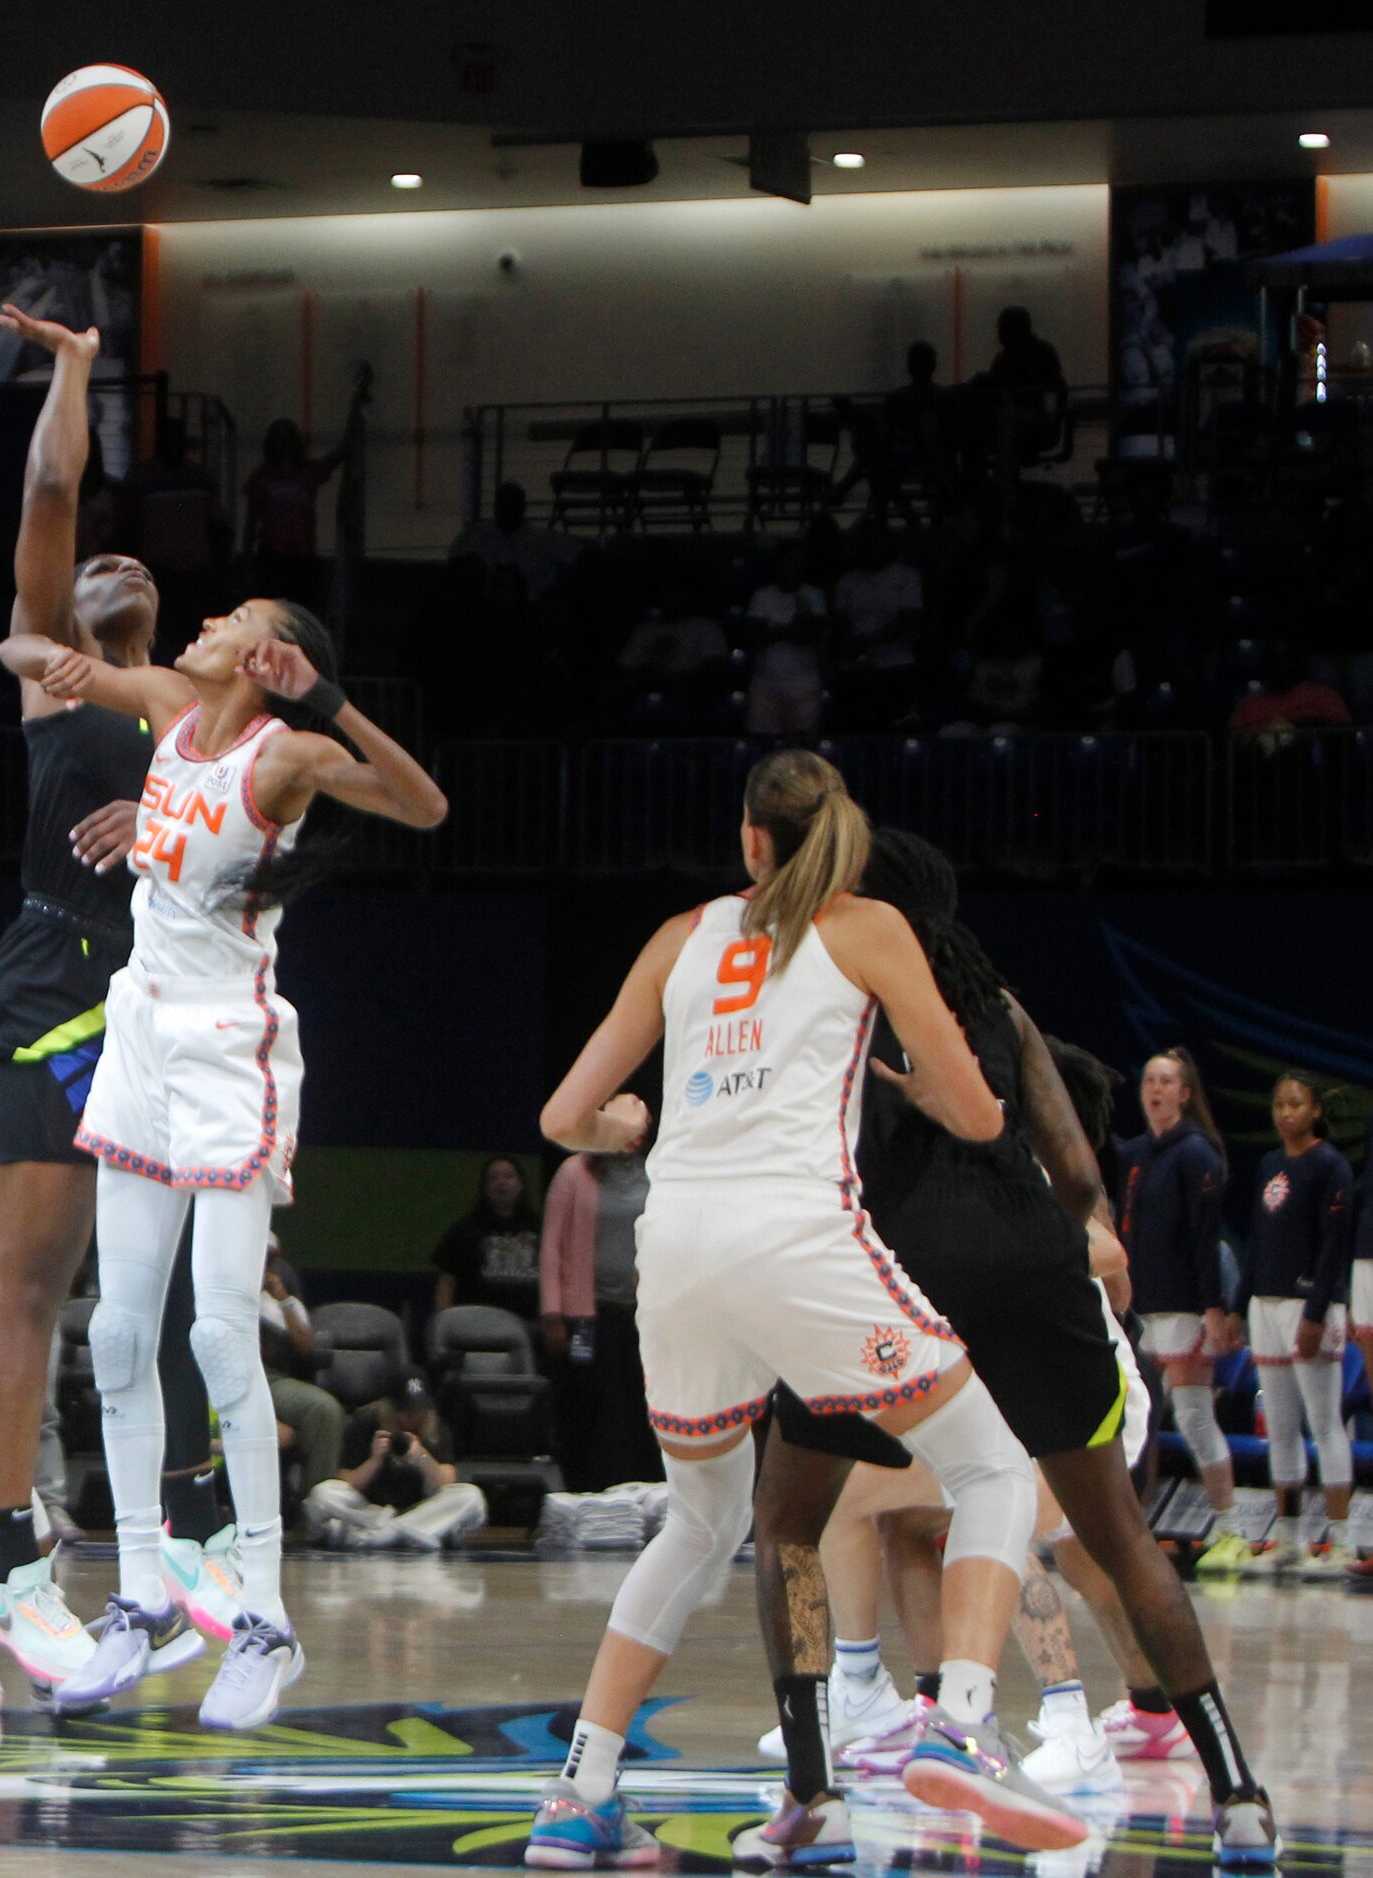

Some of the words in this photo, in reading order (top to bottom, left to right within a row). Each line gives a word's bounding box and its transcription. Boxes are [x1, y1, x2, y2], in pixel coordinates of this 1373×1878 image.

[140, 773, 228, 836] SUN
[132, 817, 187, 884] 24
[712, 933, 773, 1016] 9
[704, 1017, 764, 1058] ALLEN
[716, 1066, 773, 1098] AT&T
